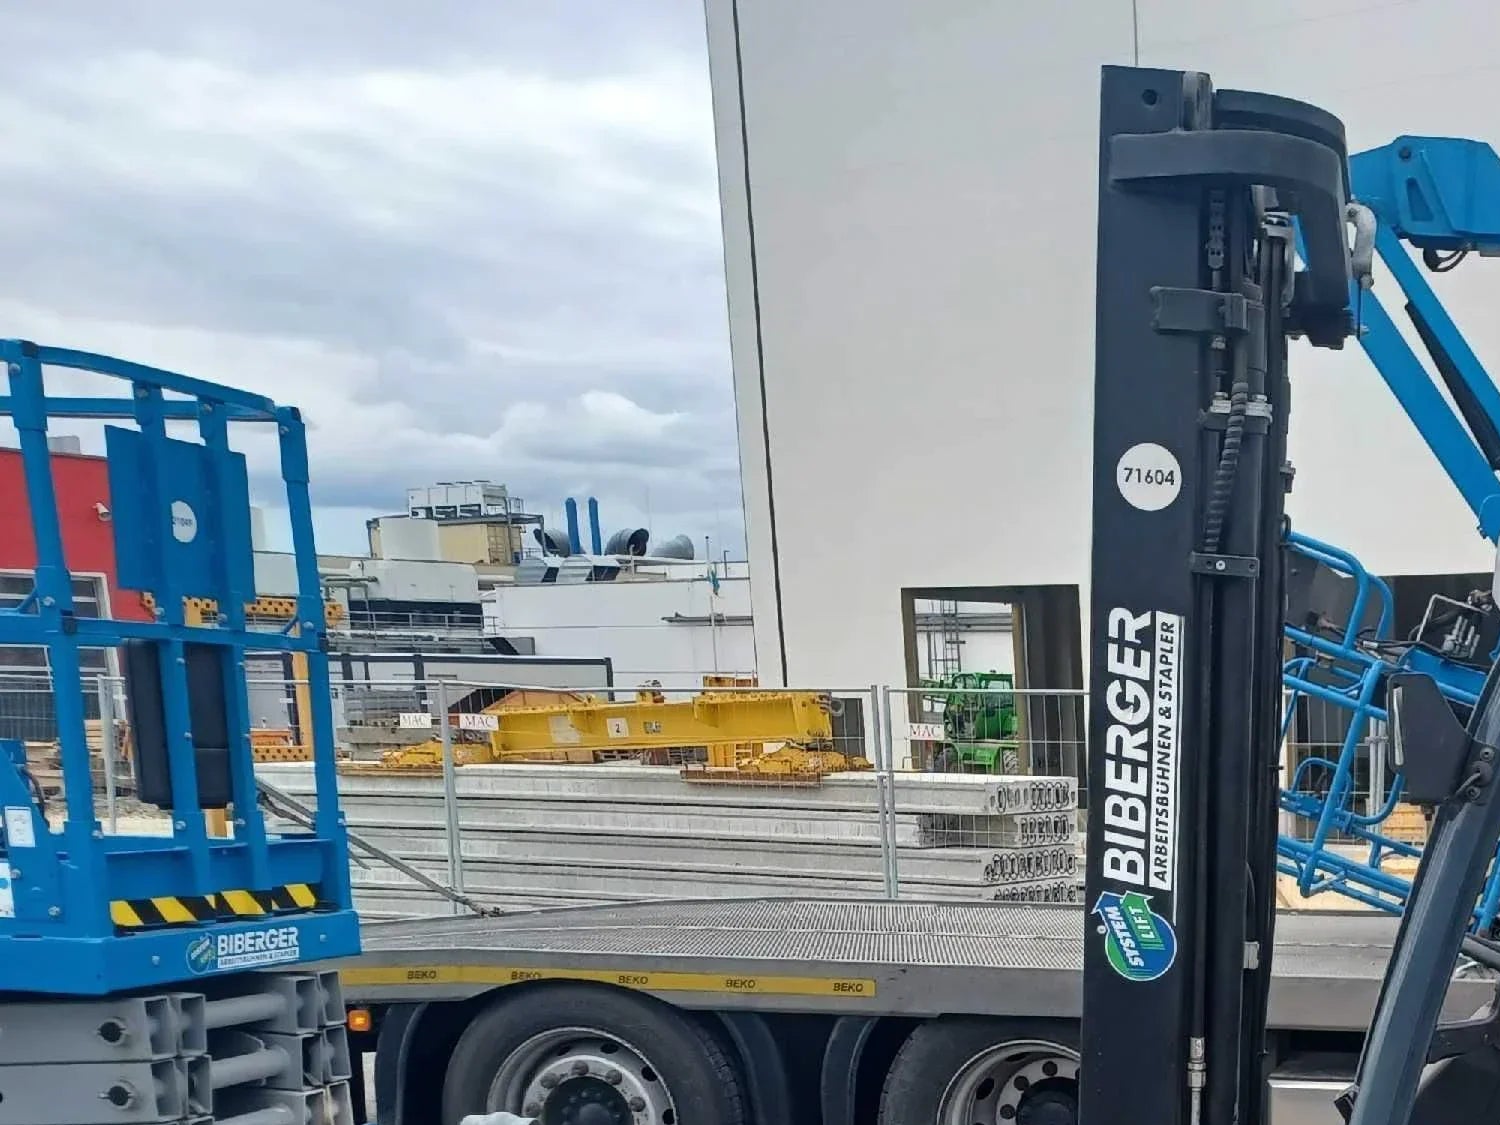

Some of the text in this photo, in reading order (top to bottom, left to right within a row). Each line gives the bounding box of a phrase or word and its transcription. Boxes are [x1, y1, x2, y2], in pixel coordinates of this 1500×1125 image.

[1123, 467, 1175, 485] 71604
[465, 714, 495, 728] MAC
[910, 724, 941, 737] MAC
[1102, 607, 1153, 886] BIBERGER
[1153, 620, 1176, 882] ARBEITSBÜHNEN & STAPLER
[1128, 905, 1156, 939] LIFT
[217, 926, 299, 956] BIBERGER
[1103, 906, 1145, 967] SYSTEM
[407, 970, 437, 980] BEKO
[618, 975, 649, 985] BEKO
[725, 979, 756, 989] BEKO
[833, 982, 864, 993] BEKO
